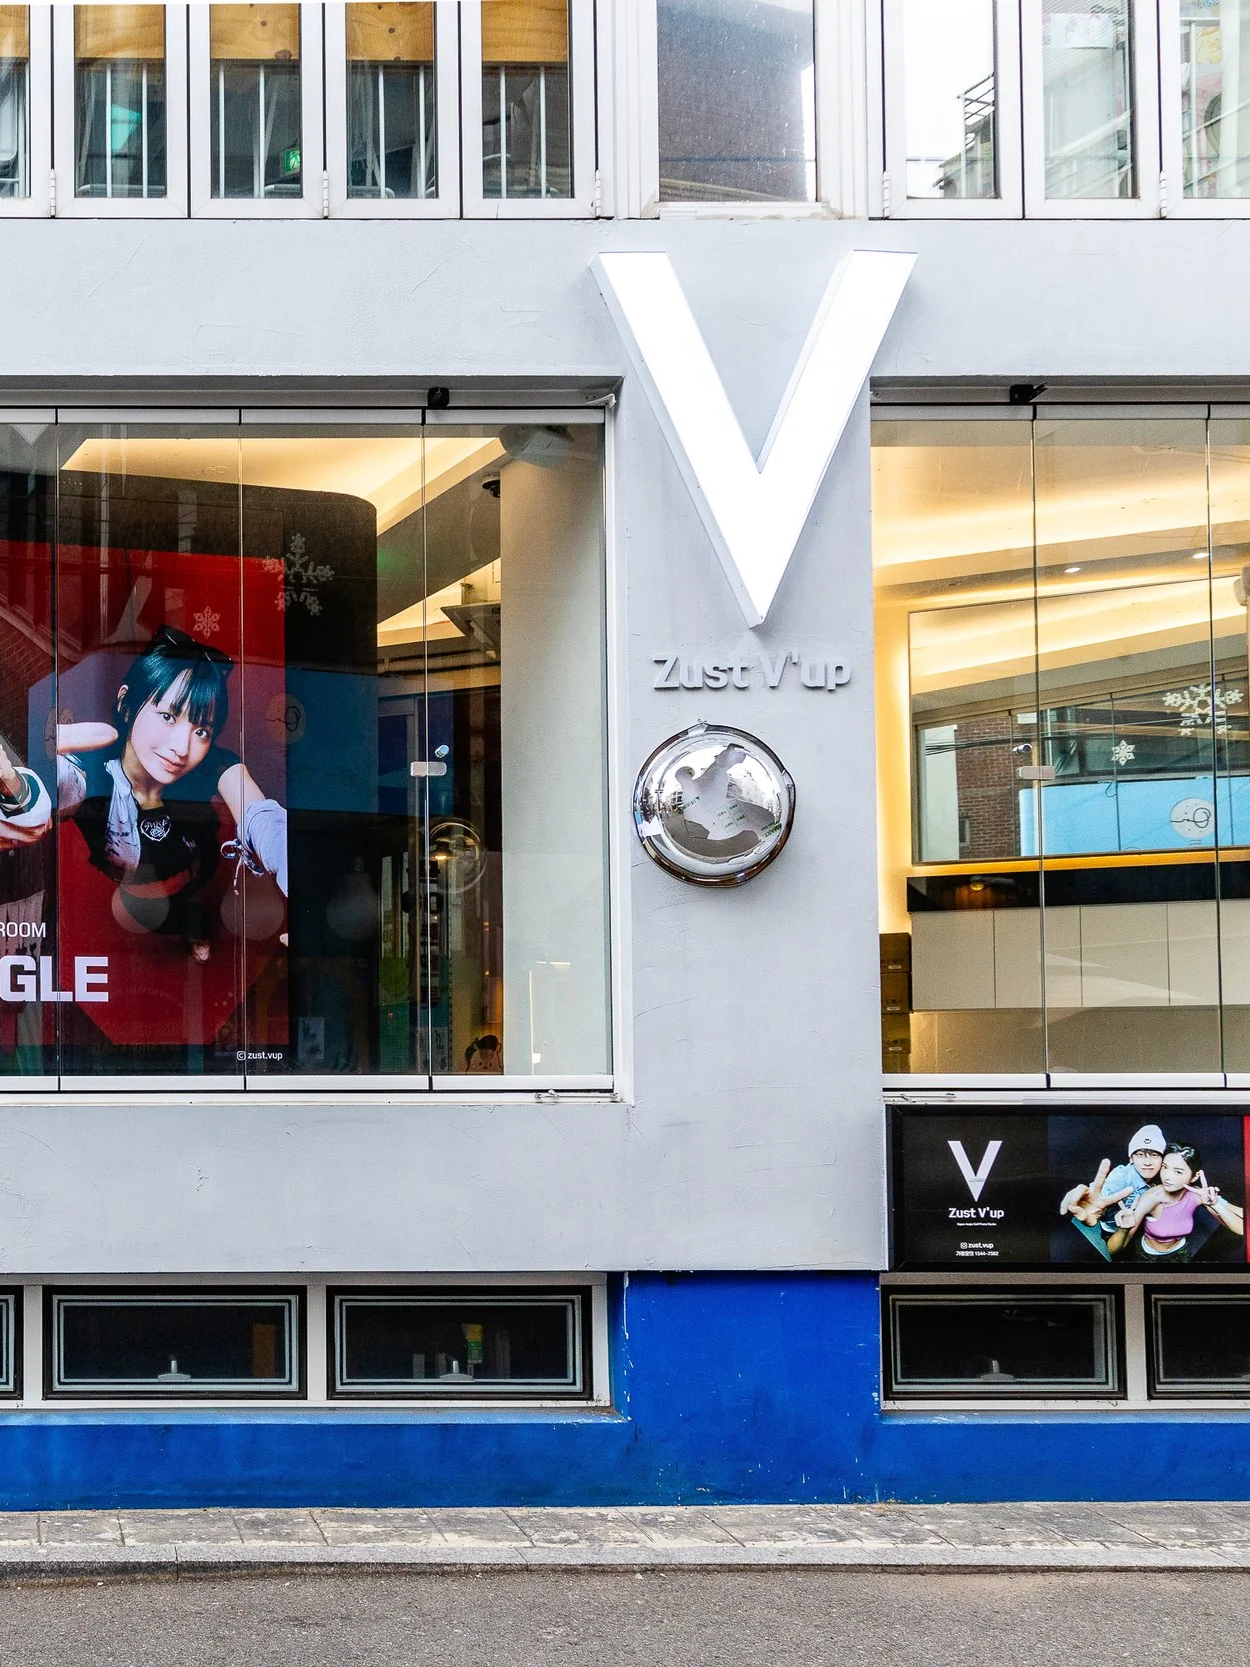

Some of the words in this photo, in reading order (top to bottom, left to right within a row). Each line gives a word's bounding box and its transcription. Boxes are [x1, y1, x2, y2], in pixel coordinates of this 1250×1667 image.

[589, 250, 918, 629] V
[653, 651, 750, 690] Zust
[760, 649, 852, 692] V'up
[247, 1051, 283, 1061] zust.vup
[947, 1140, 1003, 1202] V
[949, 1208, 977, 1218] Zust
[978, 1207, 1004, 1219] V'up
